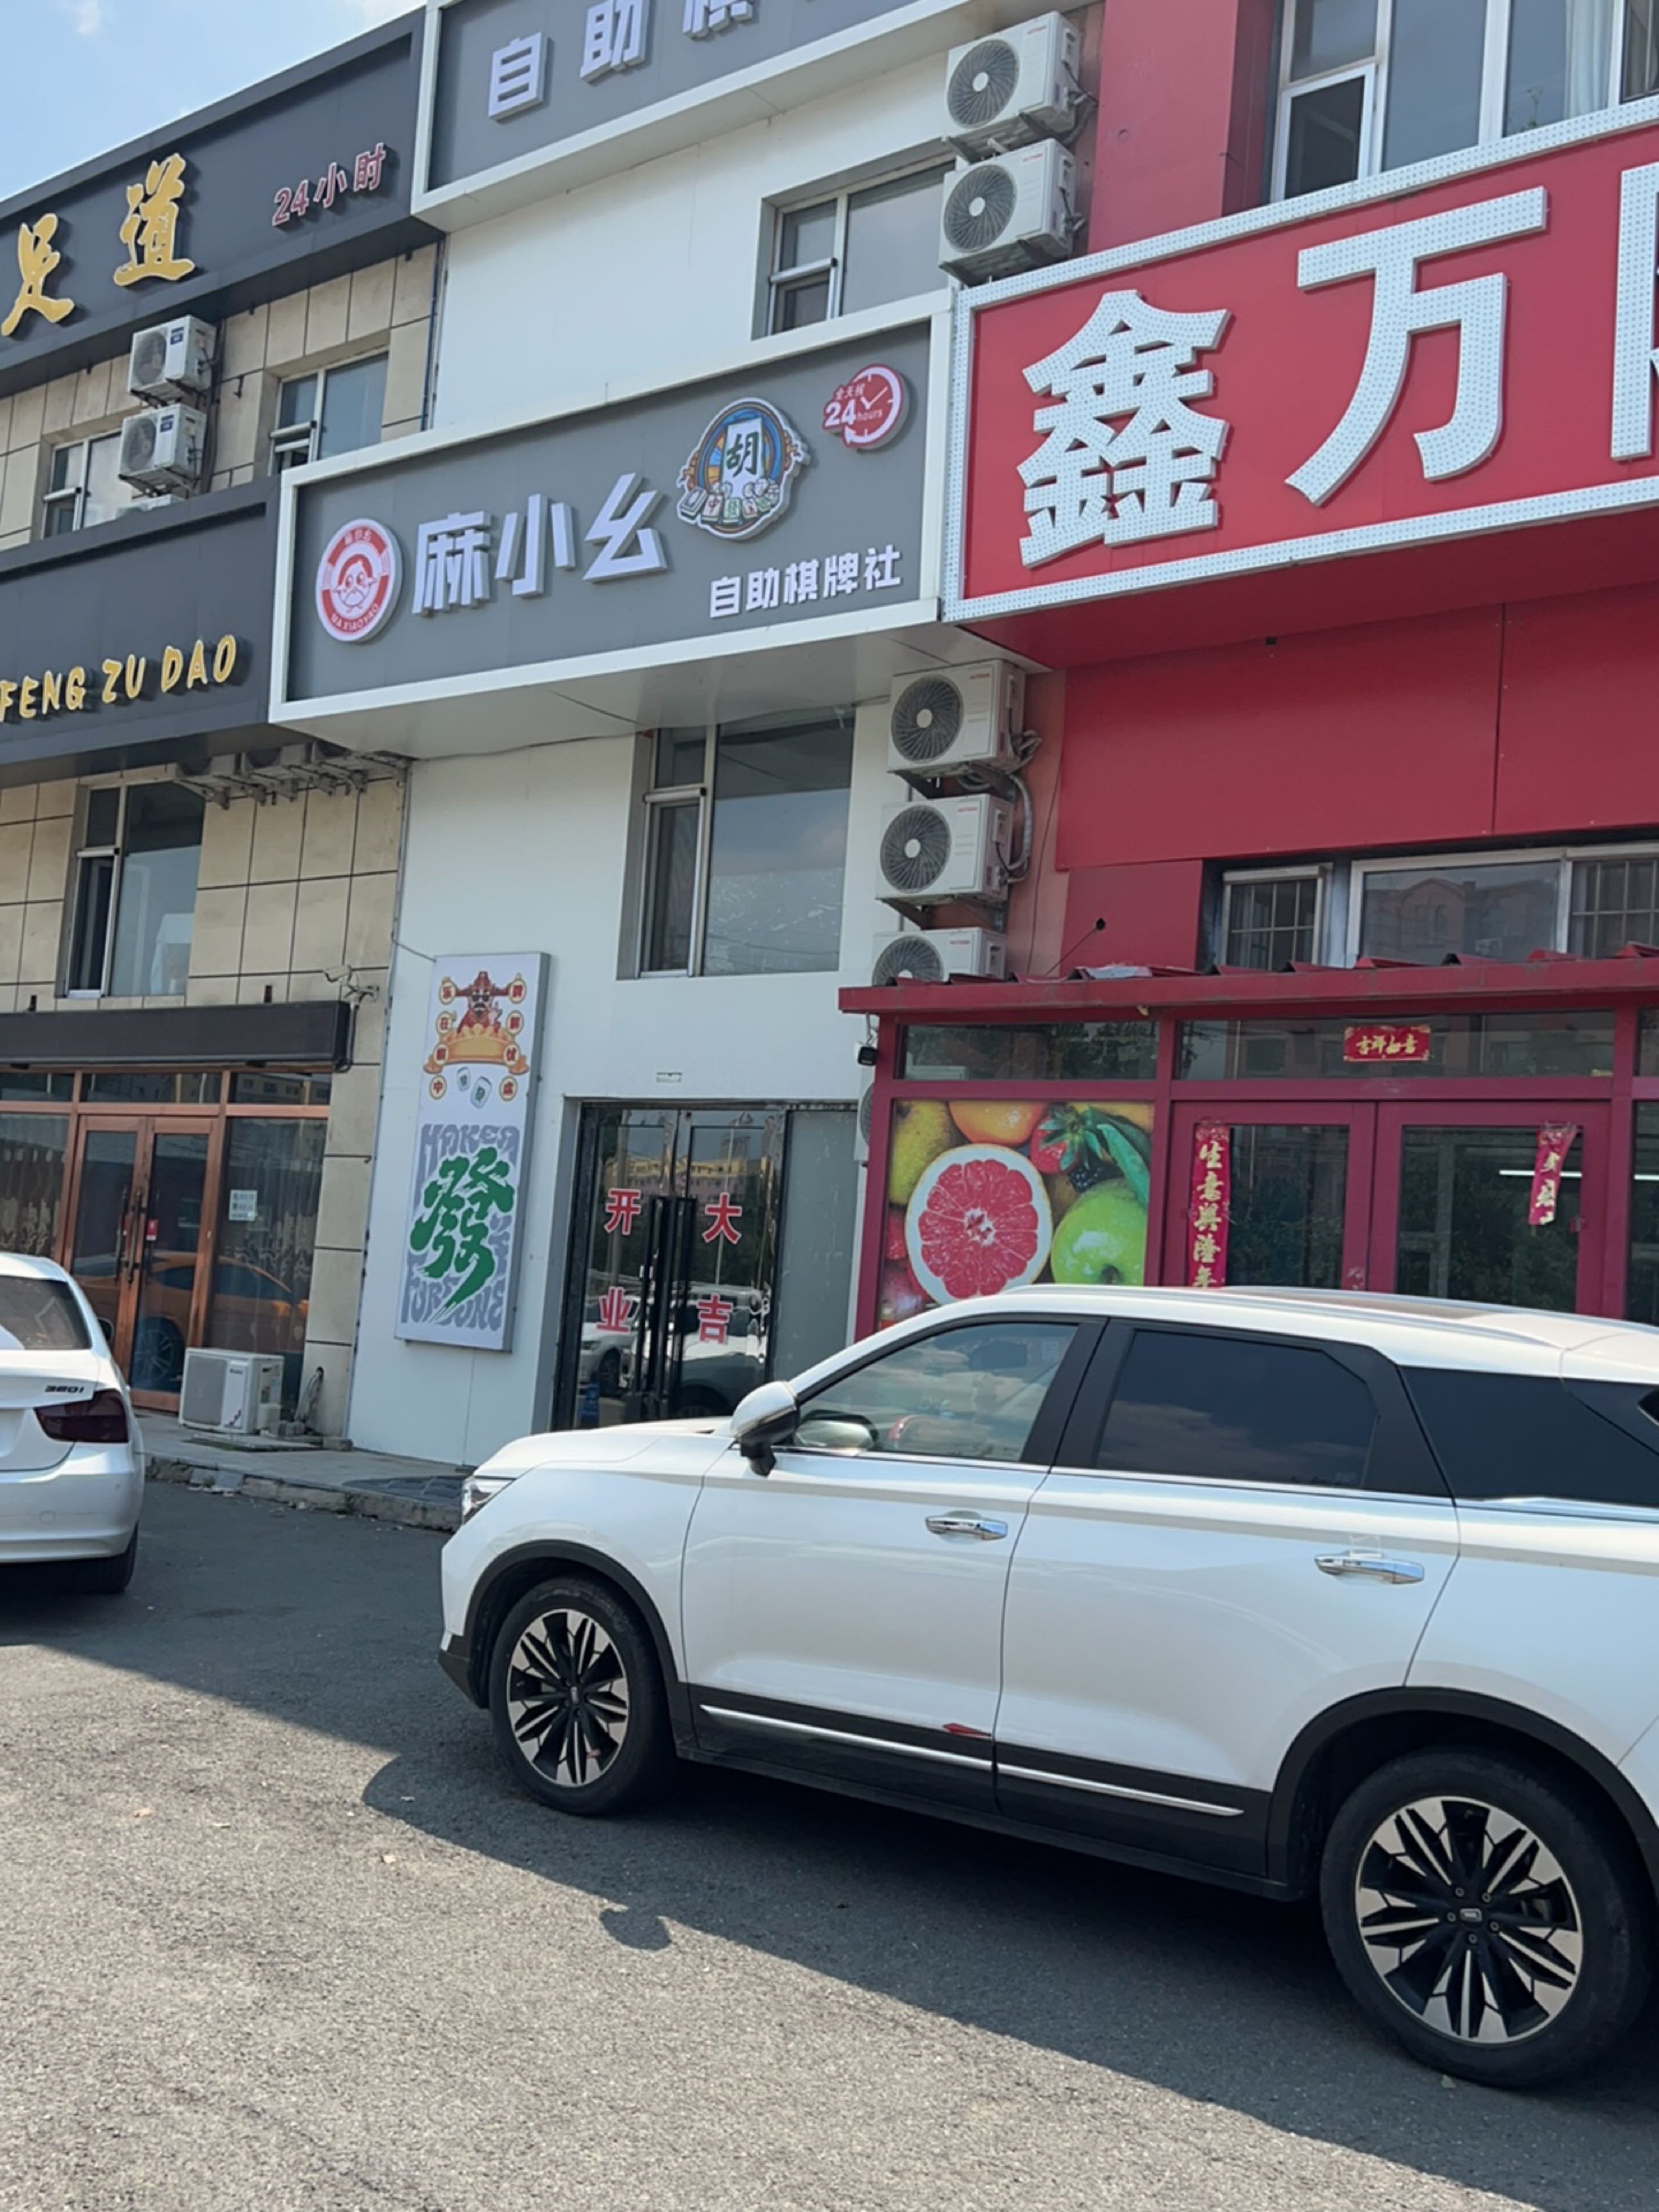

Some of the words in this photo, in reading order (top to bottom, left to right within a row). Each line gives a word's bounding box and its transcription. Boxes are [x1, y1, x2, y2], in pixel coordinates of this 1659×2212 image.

[272, 141, 386, 227] 24小时
[824, 398, 856, 428] 24
[726, 430, 761, 479] 胡
[709, 543, 901, 619] 自助棋牌社
[0, 666, 88, 723] FENG
[101, 653, 147, 704] ZU
[160, 634, 237, 694] DAO
[1355, 1032, 1419, 1055] 吉祥如意
